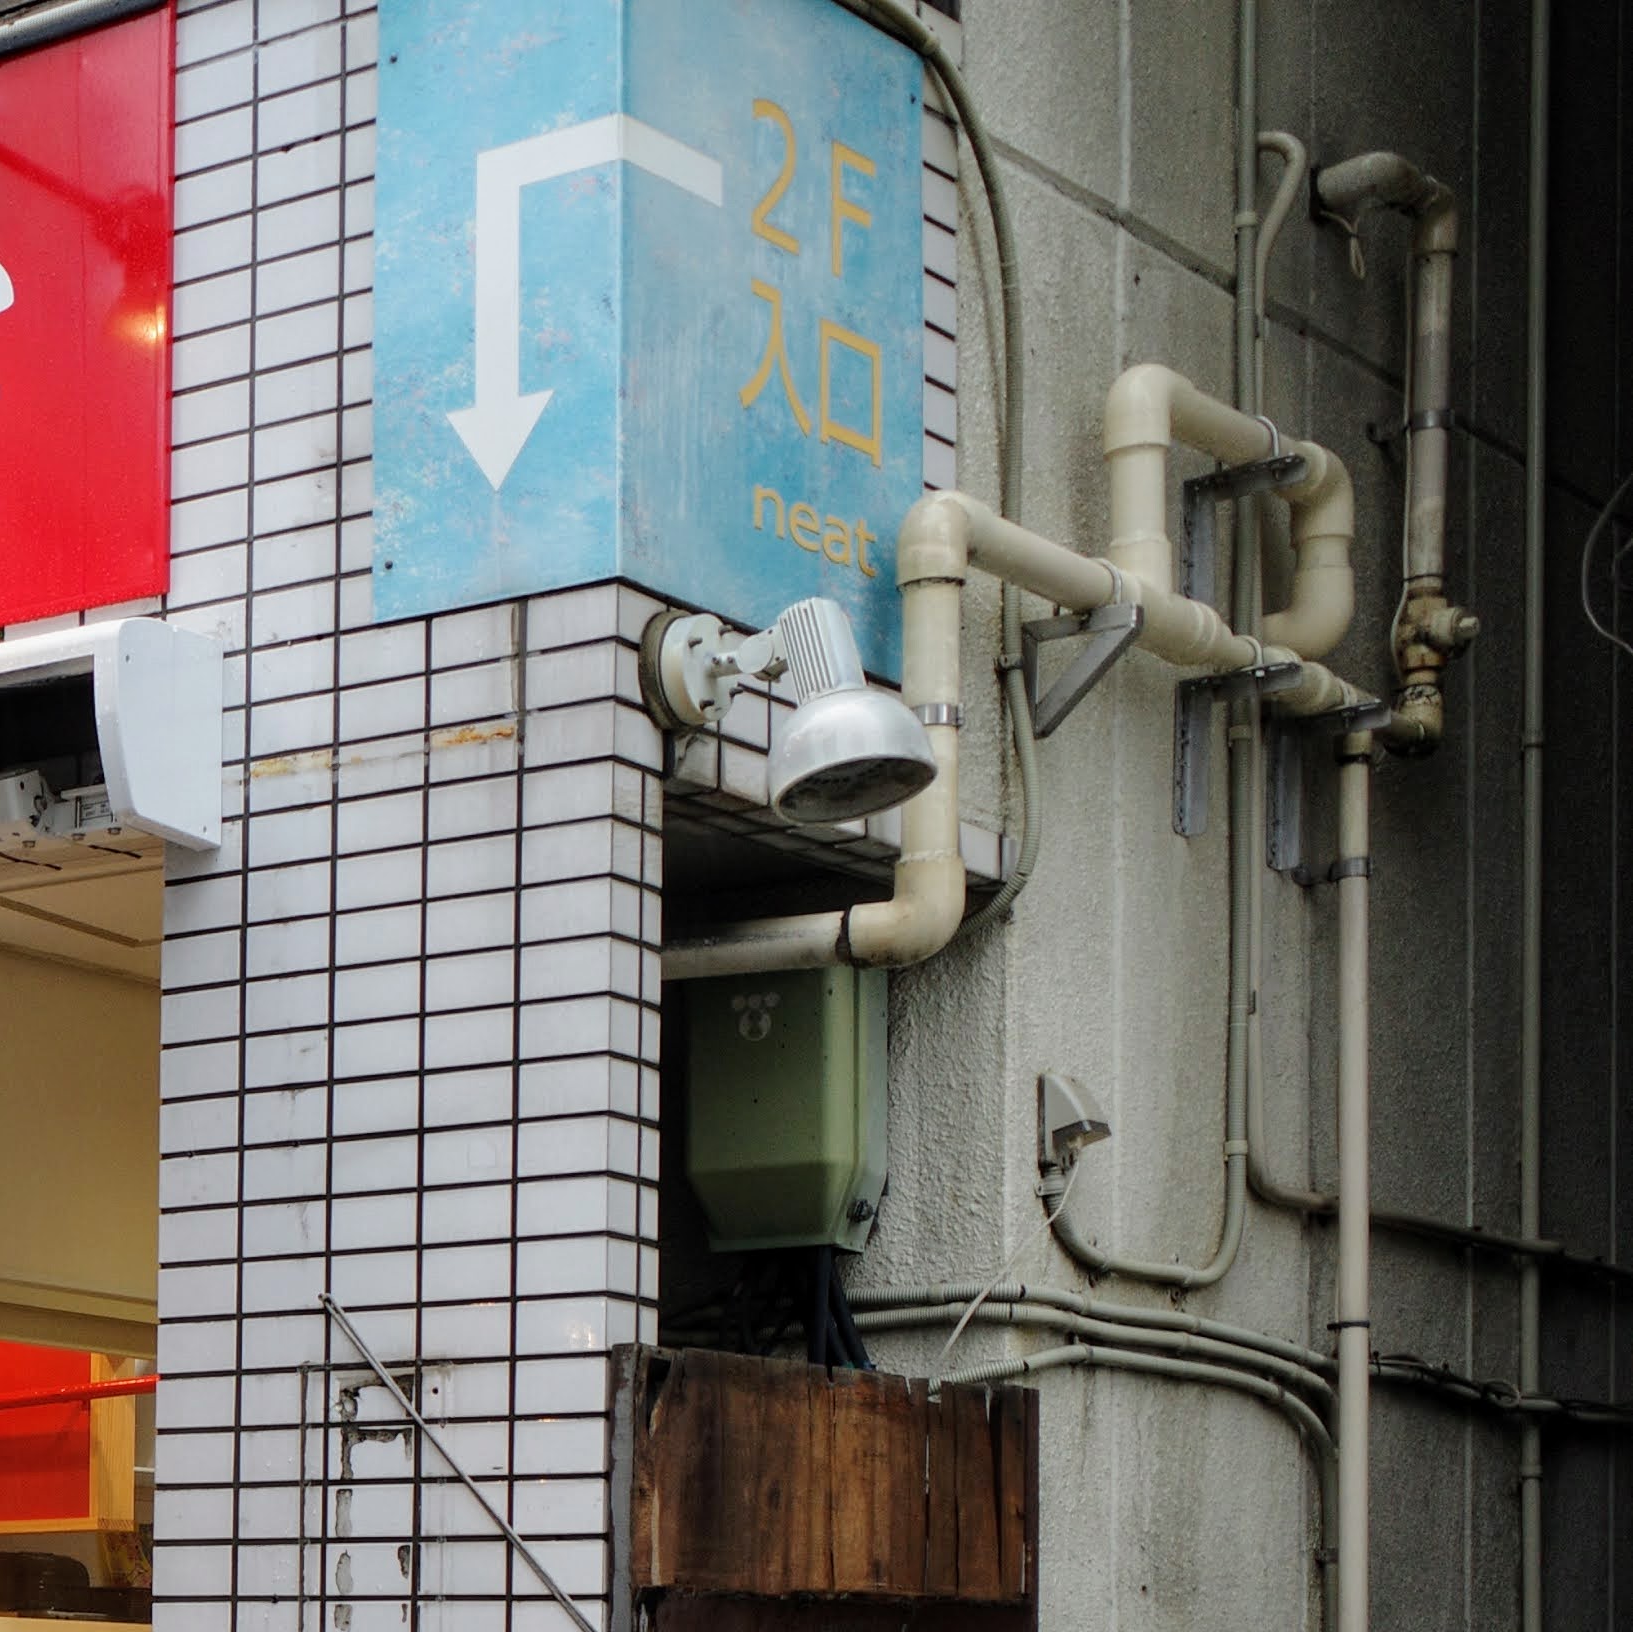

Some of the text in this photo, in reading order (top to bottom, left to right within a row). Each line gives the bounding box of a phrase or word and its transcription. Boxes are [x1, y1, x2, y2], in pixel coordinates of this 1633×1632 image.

[751, 98, 877, 279] 2F
[738, 278, 882, 468] 入口
[751, 484, 877, 577] neat
